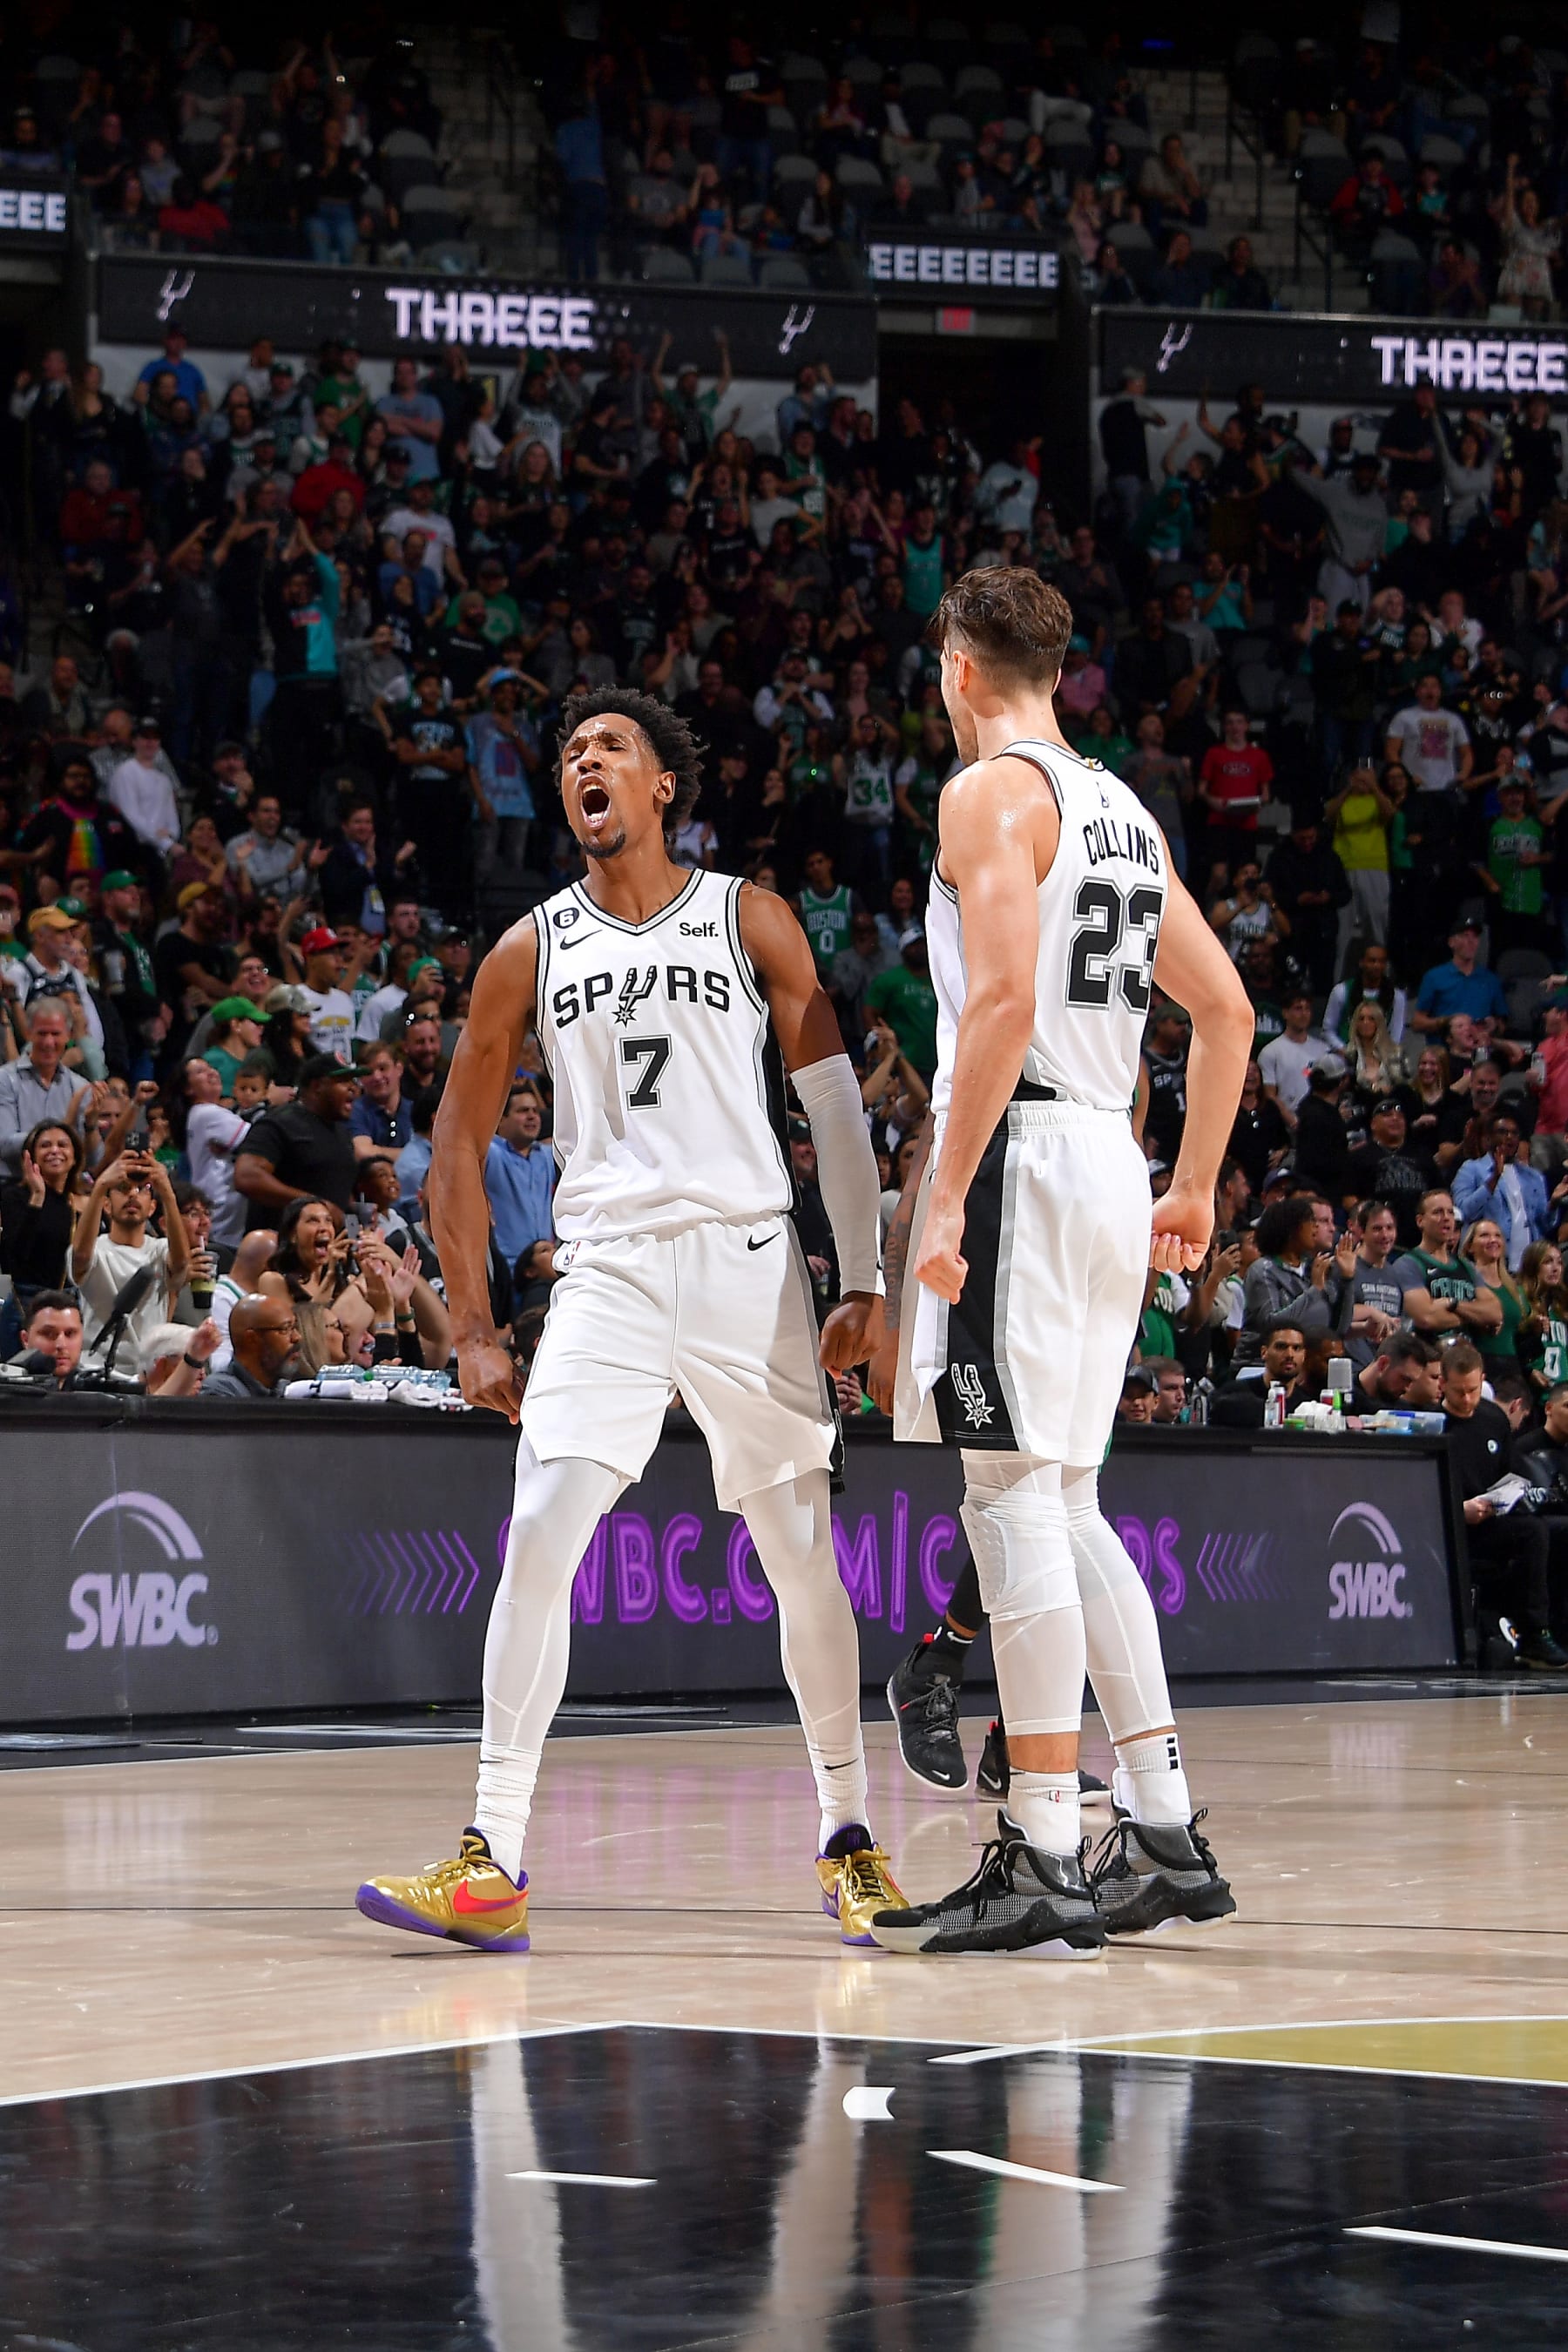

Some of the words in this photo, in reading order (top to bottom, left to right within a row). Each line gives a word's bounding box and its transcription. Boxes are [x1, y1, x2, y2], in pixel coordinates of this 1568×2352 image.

[1083, 817, 1159, 875] COLLINS
[679, 922, 719, 938] Self.
[820, 930, 835, 953] 0
[1065, 875, 1164, 1016] 23
[553, 965, 730, 1029] SPURS
[619, 1034, 673, 1111] 7
